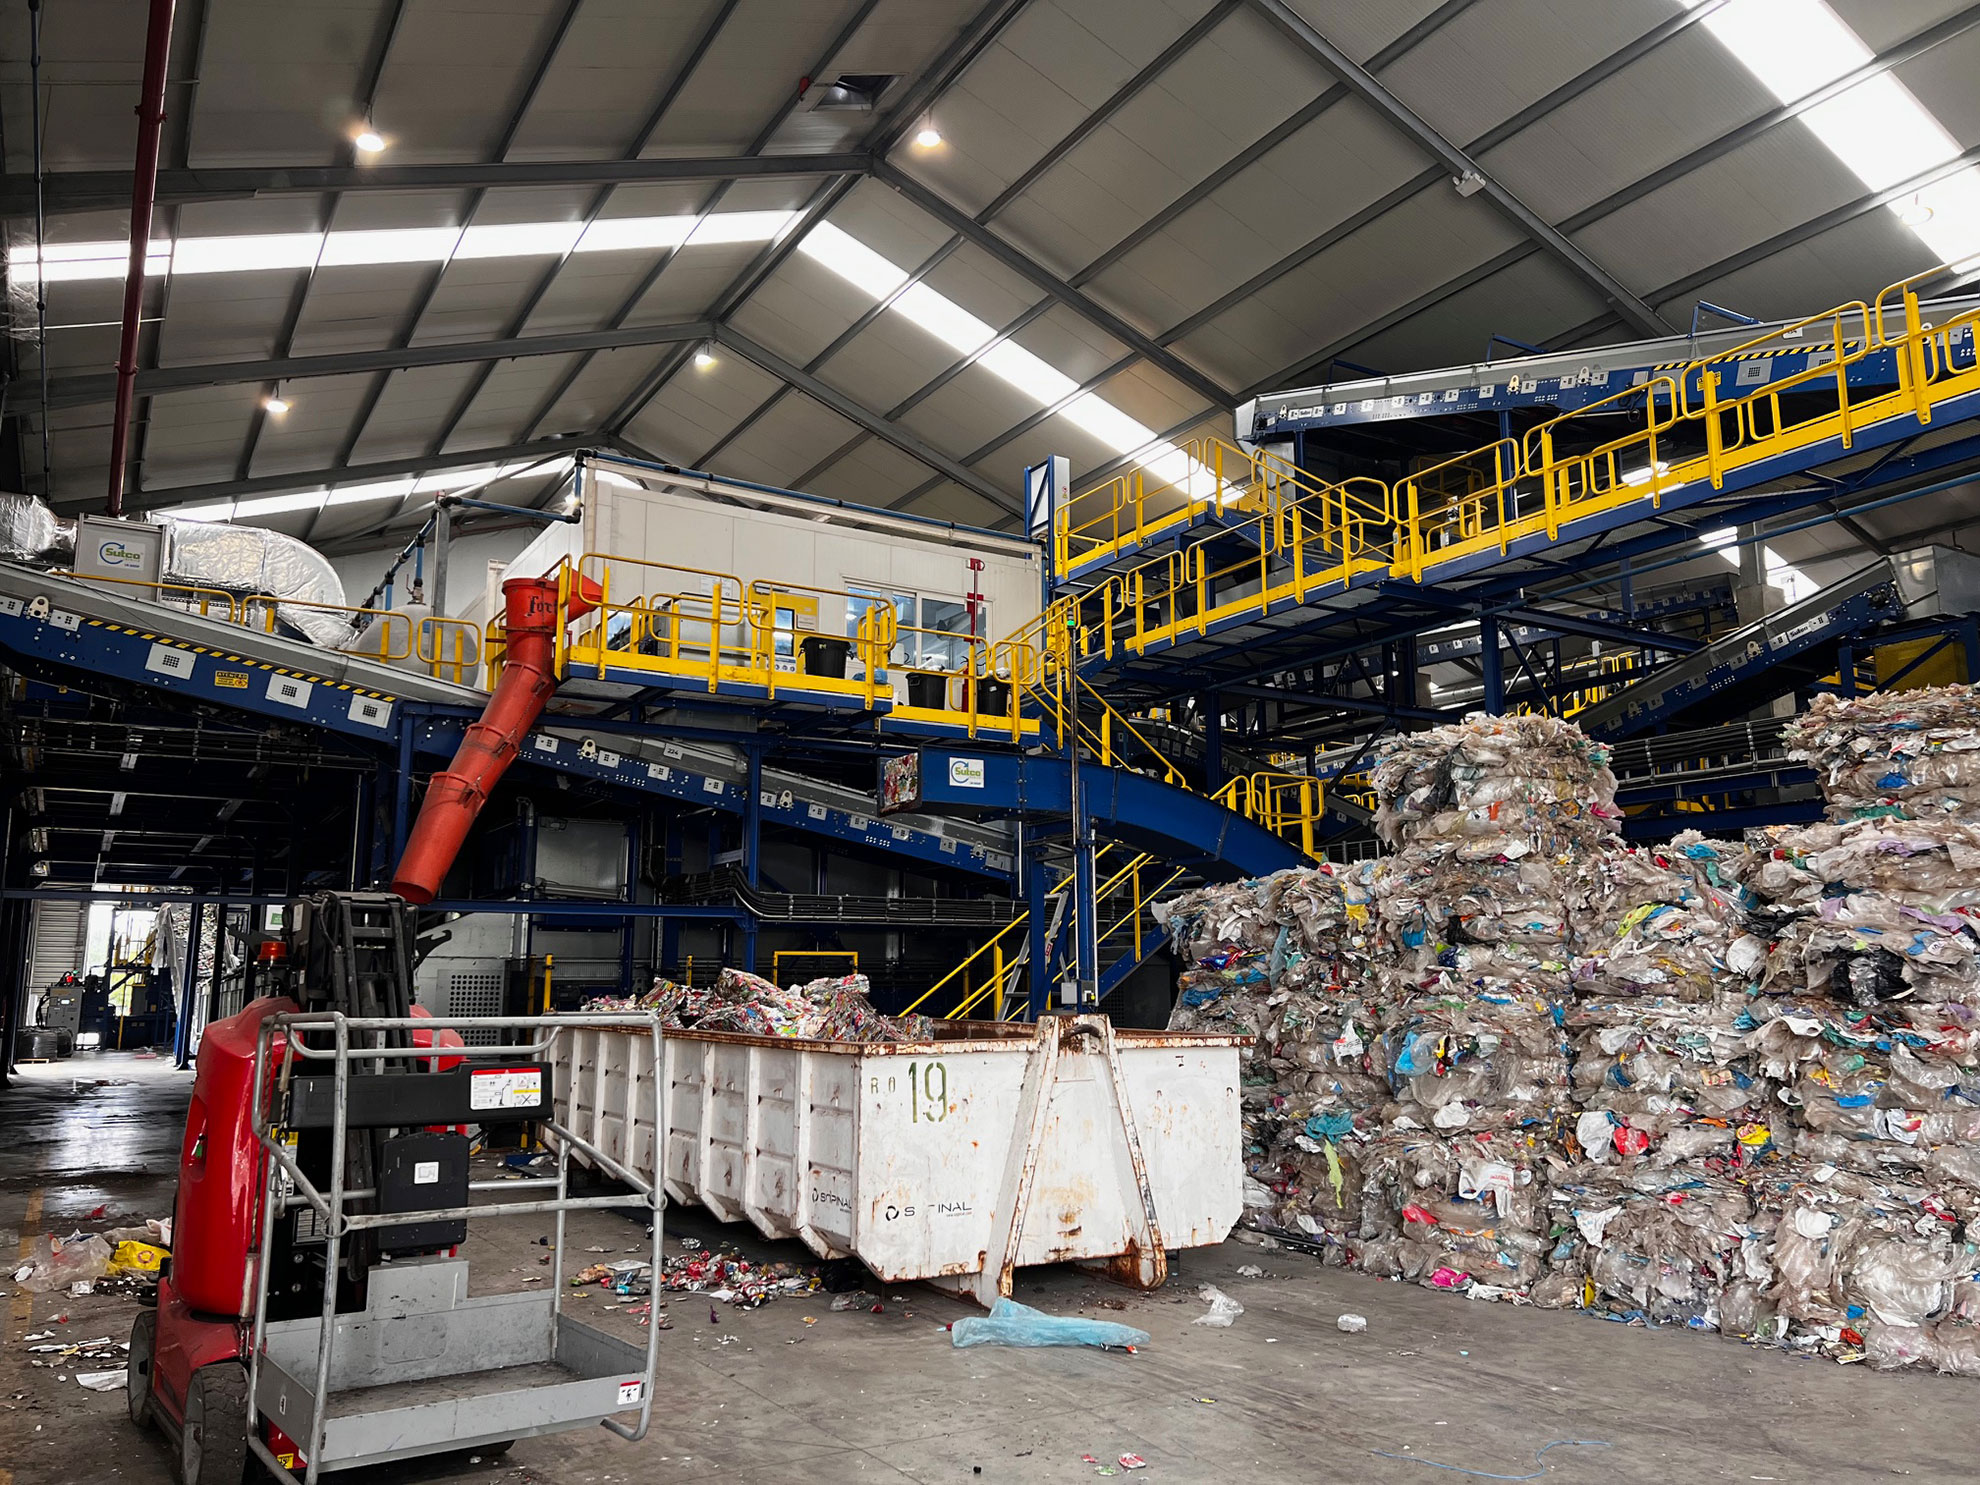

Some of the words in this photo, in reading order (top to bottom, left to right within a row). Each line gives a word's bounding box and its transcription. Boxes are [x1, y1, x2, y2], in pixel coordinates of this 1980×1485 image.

[105, 547, 141, 560] Sutco
[955, 766, 982, 777] Sutco
[908, 1062, 947, 1123] 19
